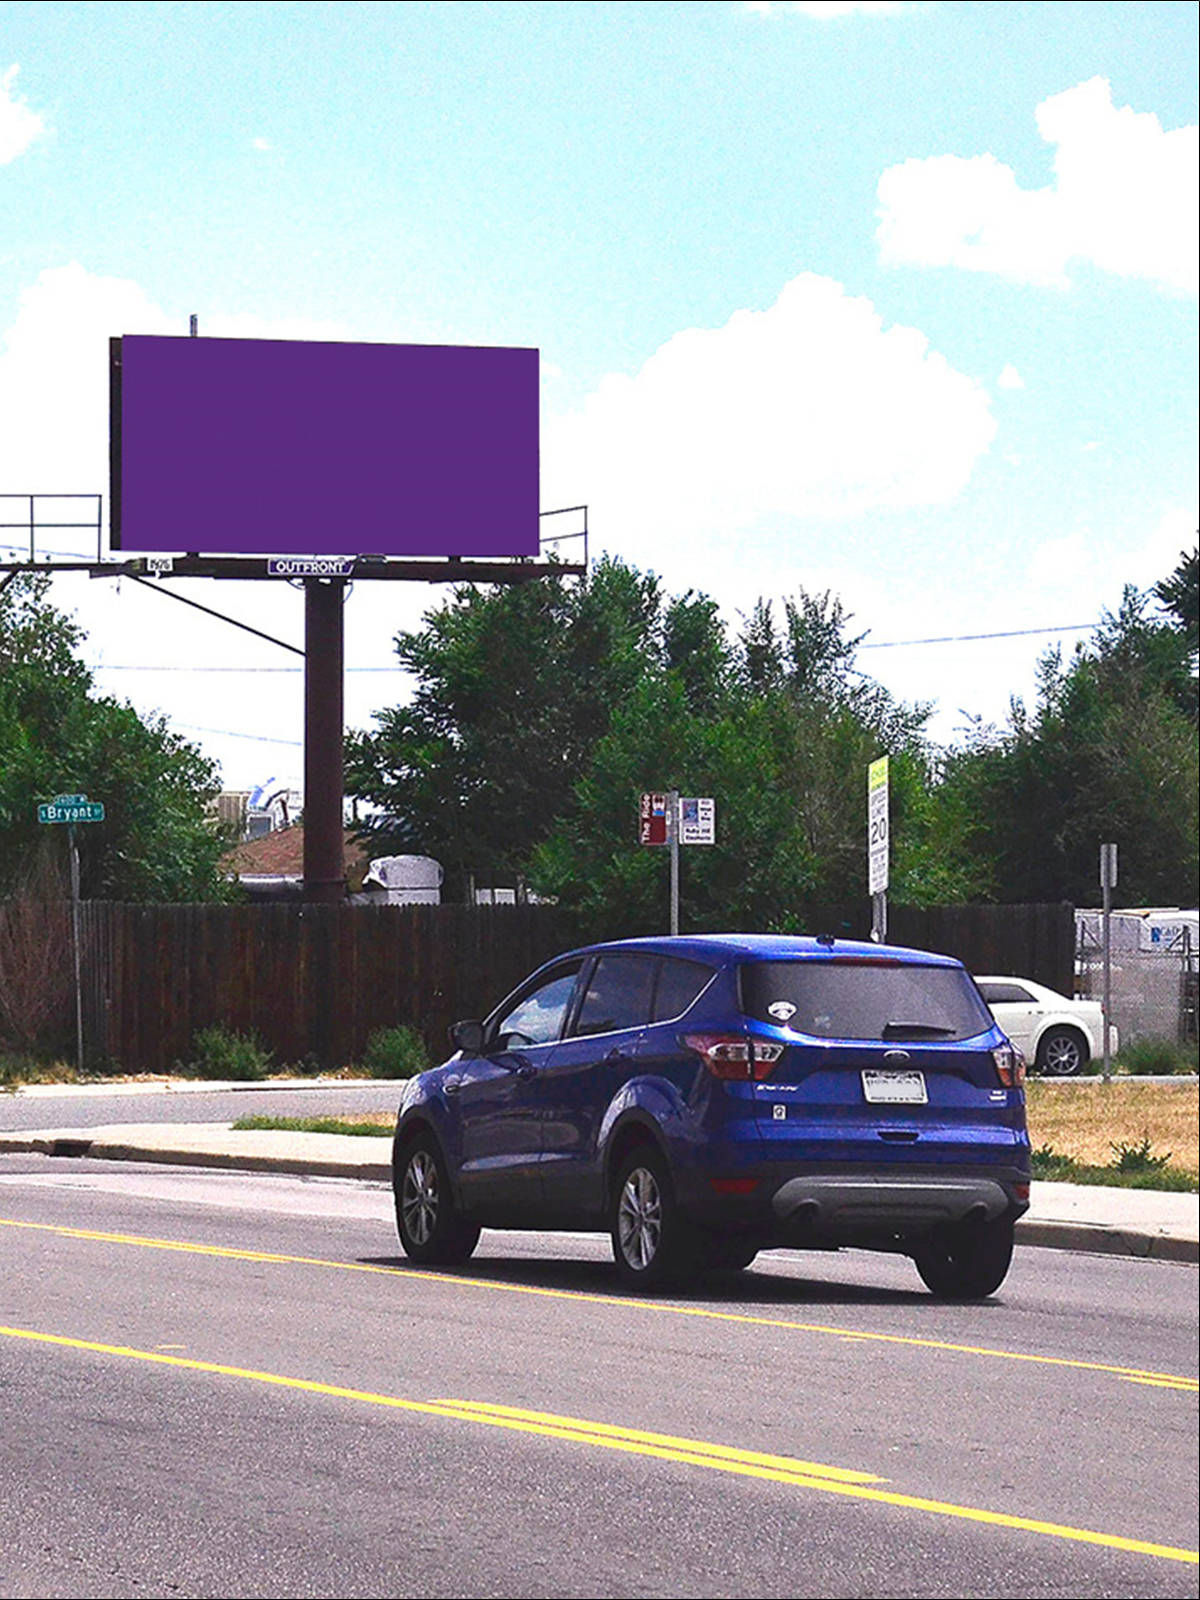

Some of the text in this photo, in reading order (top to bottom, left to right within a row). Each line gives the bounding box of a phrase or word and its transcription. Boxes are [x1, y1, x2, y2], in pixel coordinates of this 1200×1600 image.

[276, 561, 346, 573] OUTFRONT
[47, 806, 92, 821] Bryant
[641, 822, 651, 841] The
[871, 817, 887, 846] 20
